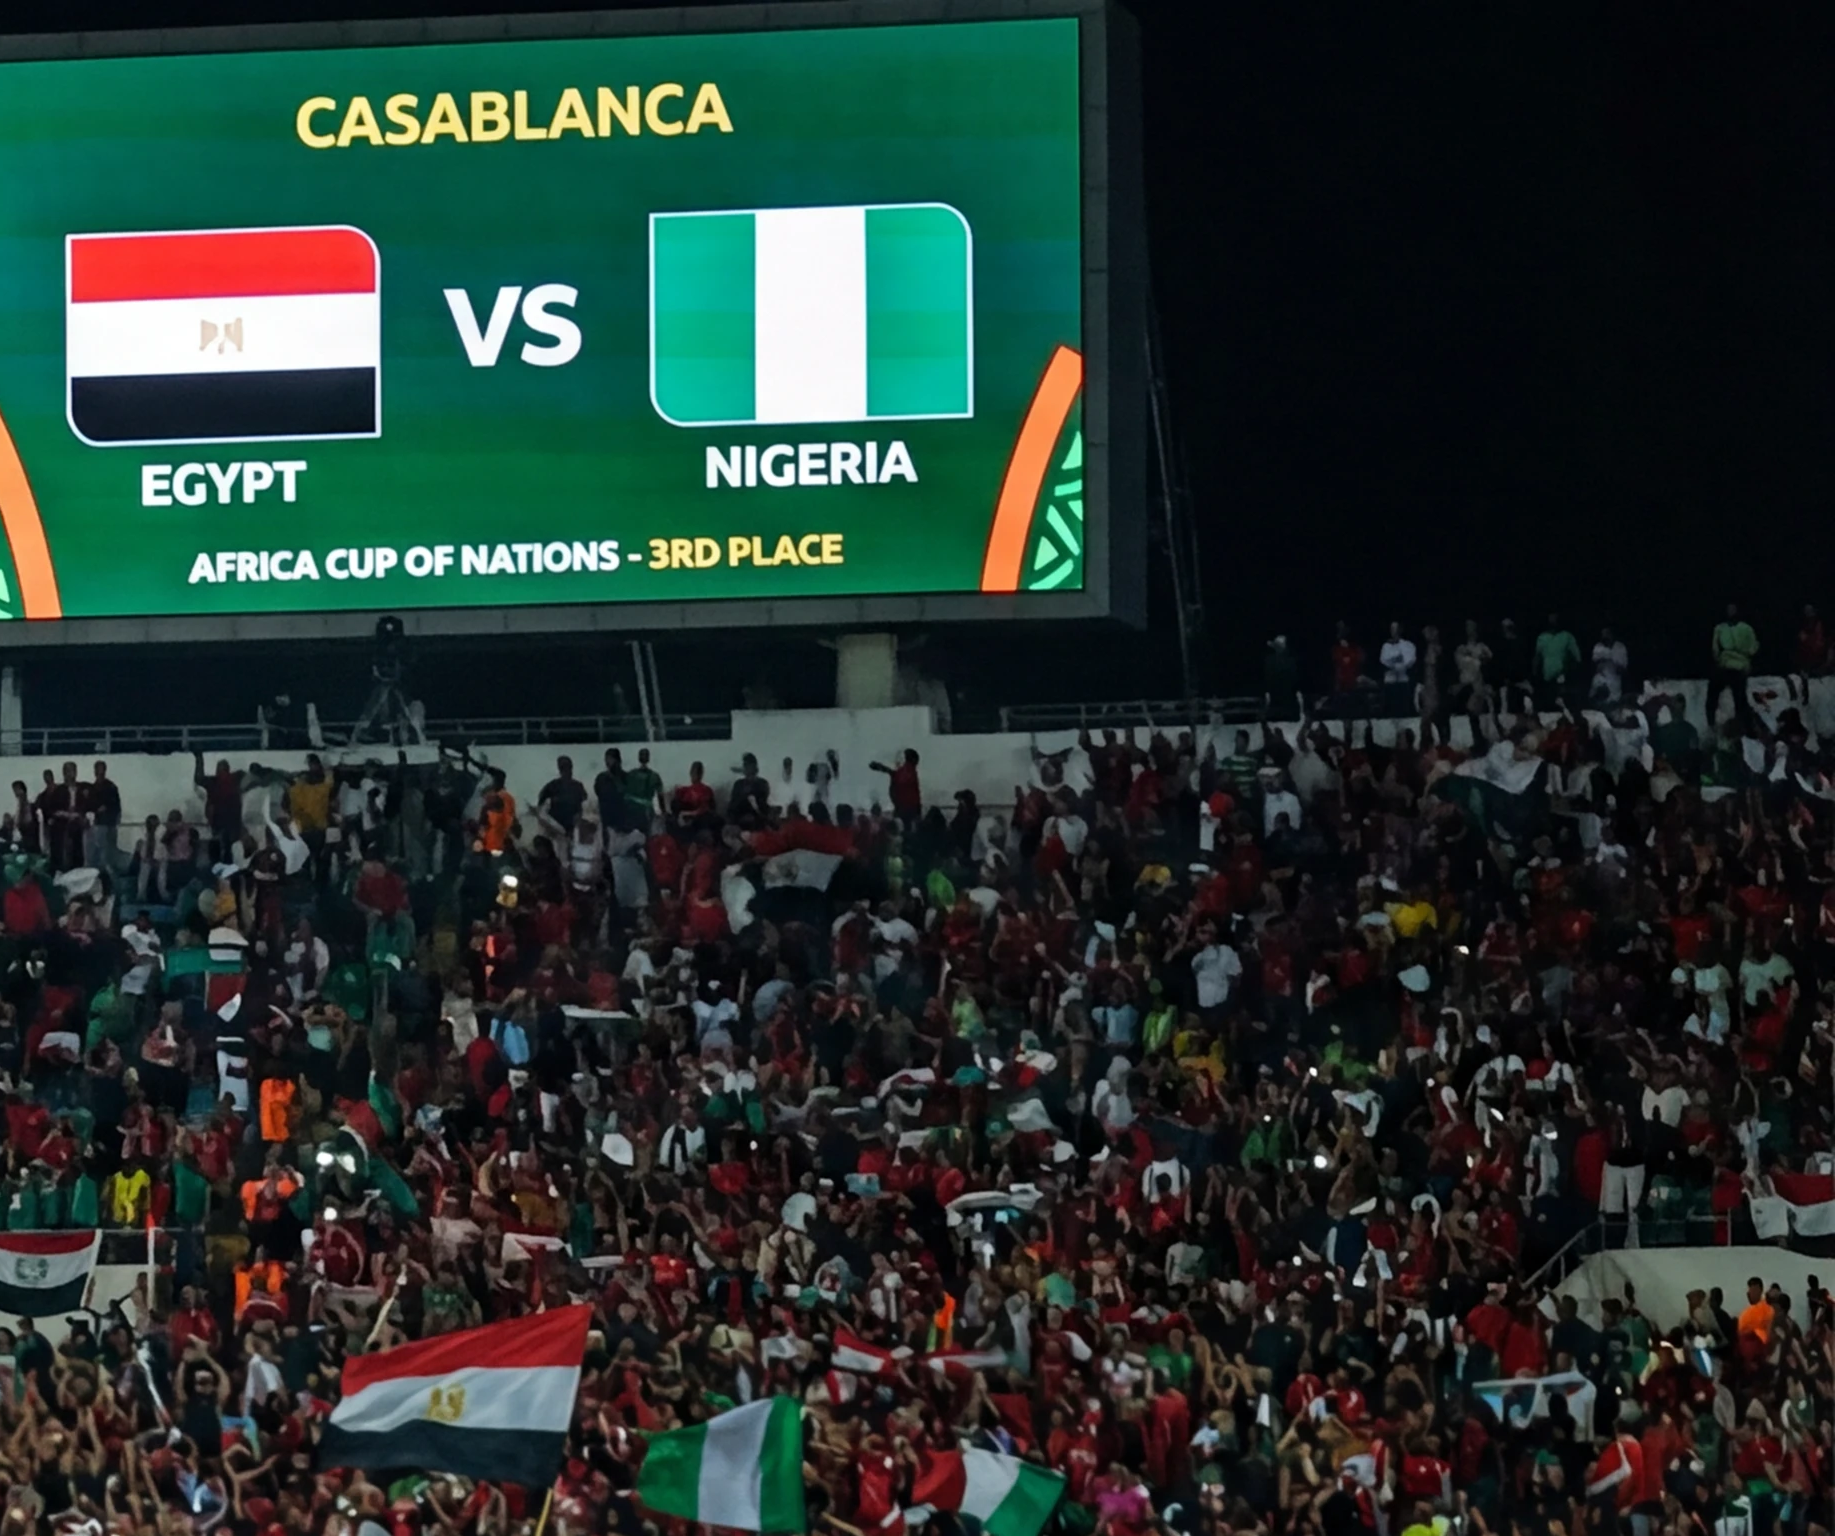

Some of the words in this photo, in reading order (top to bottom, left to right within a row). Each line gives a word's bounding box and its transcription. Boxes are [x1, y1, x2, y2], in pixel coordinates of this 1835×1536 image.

[296, 83, 734, 149] CASABLANCA
[443, 283, 583, 368] VS
[140, 459, 308, 508] EGYPT
[705, 439, 919, 490] NIGERIA
[188, 550, 320, 583] AFRICA
[326, 548, 397, 580] CUP
[404, 545, 455, 577] OF
[461, 540, 620, 575] NATIONS
[627, 553, 642, 562] -
[649, 537, 721, 570] 3RD
[728, 533, 844, 567] PLACE
